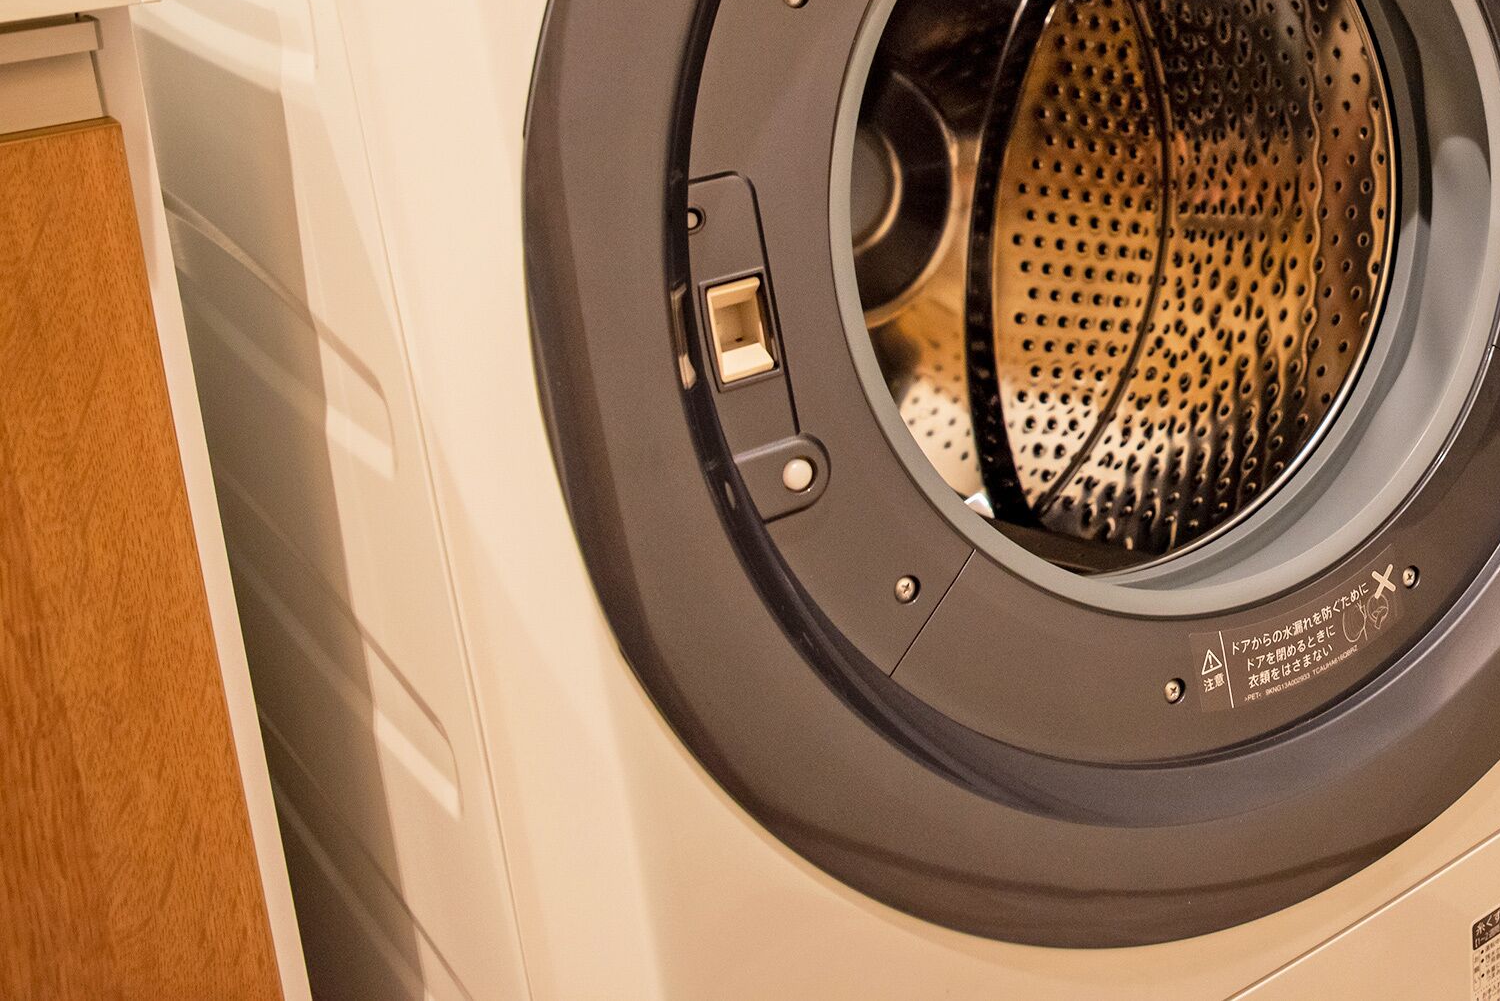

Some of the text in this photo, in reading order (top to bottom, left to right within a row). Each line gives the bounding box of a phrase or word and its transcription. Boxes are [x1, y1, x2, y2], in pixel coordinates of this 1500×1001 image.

[1231, 582, 1370, 656] ドアからの水漏れを防ぐために
[1247, 624, 1336, 672] ドアを閉めるときに
[1248, 645, 1333, 689] 衣類をはさまない
[1203, 672, 1226, 692] 注意
